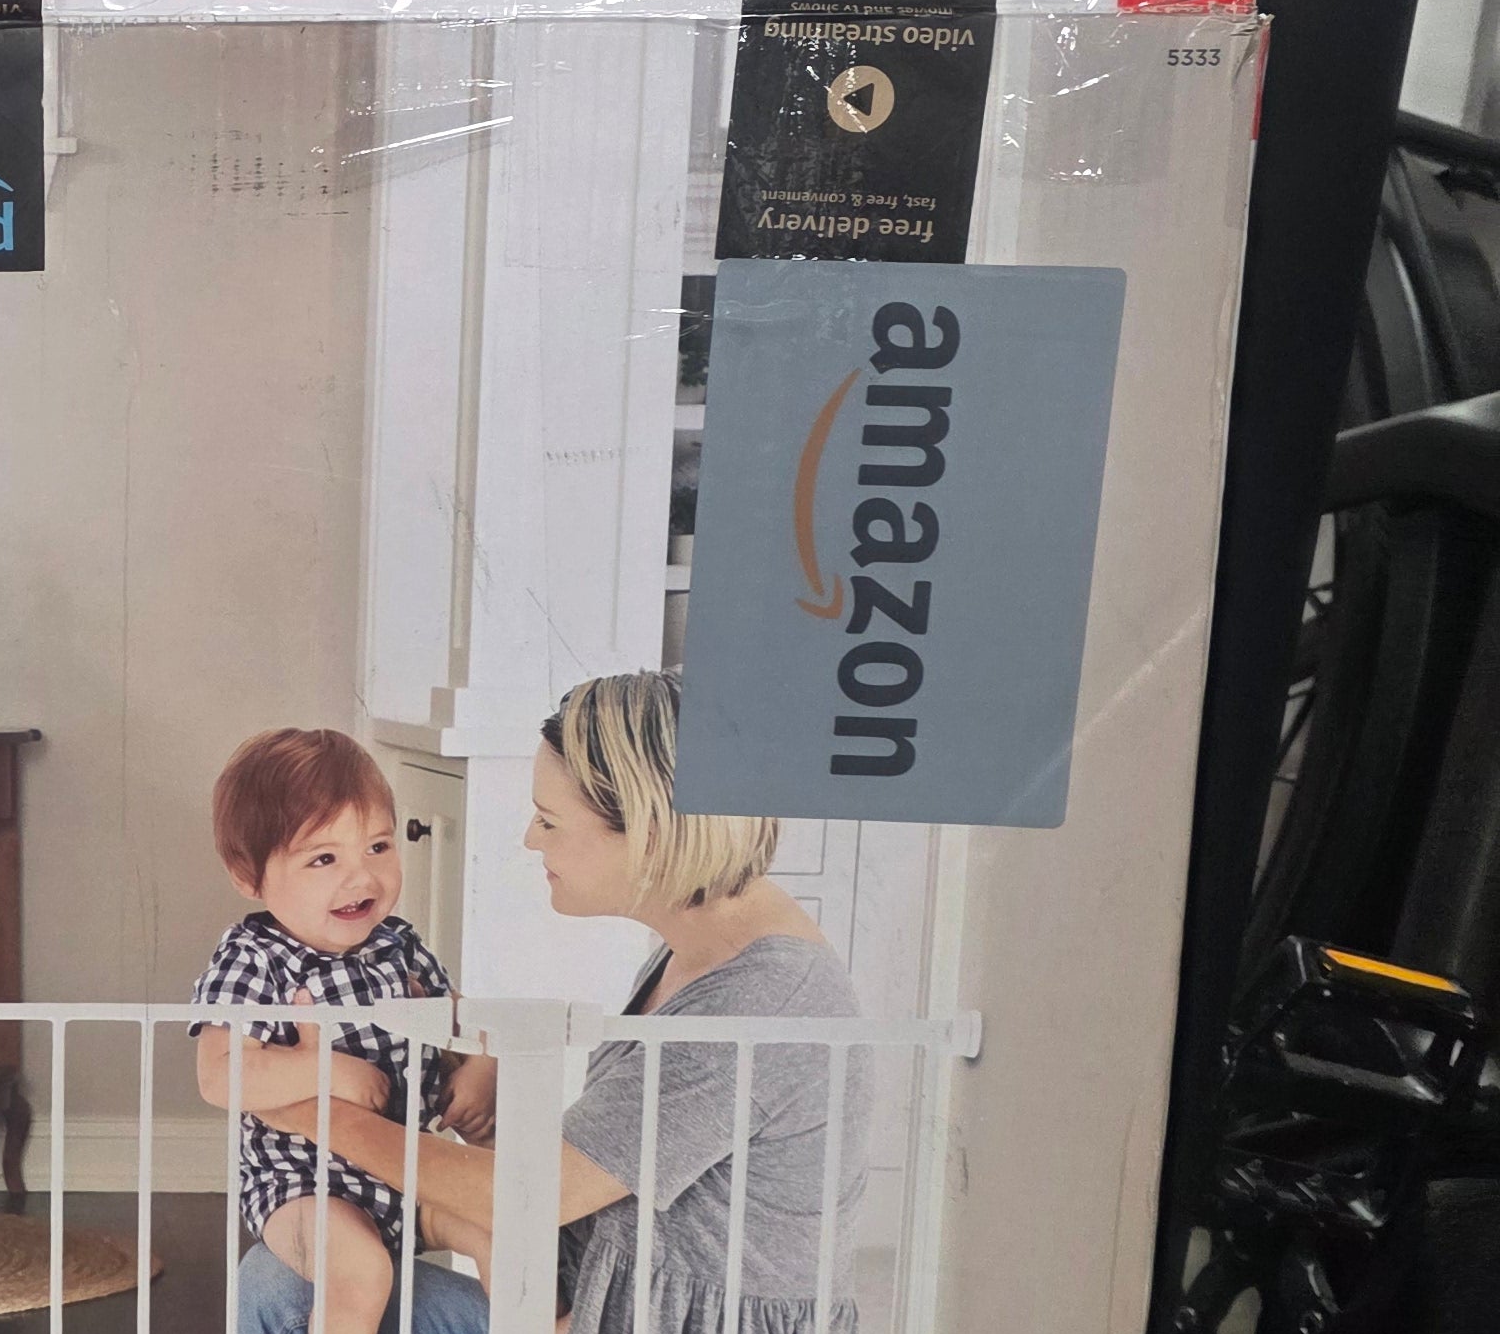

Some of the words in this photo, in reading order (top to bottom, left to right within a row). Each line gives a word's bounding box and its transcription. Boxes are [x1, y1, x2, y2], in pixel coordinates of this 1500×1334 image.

[763, 16, 897, 46] streaming
[902, 25, 976, 52] video
[1166, 48, 1221, 67] 5333
[760, 189, 847, 205] convenient
[866, 194, 899, 210] free
[902, 193, 937, 212] fast,
[757, 206, 871, 240] delivery
[878, 218, 935, 244] free
[829, 299, 962, 778] amazon
